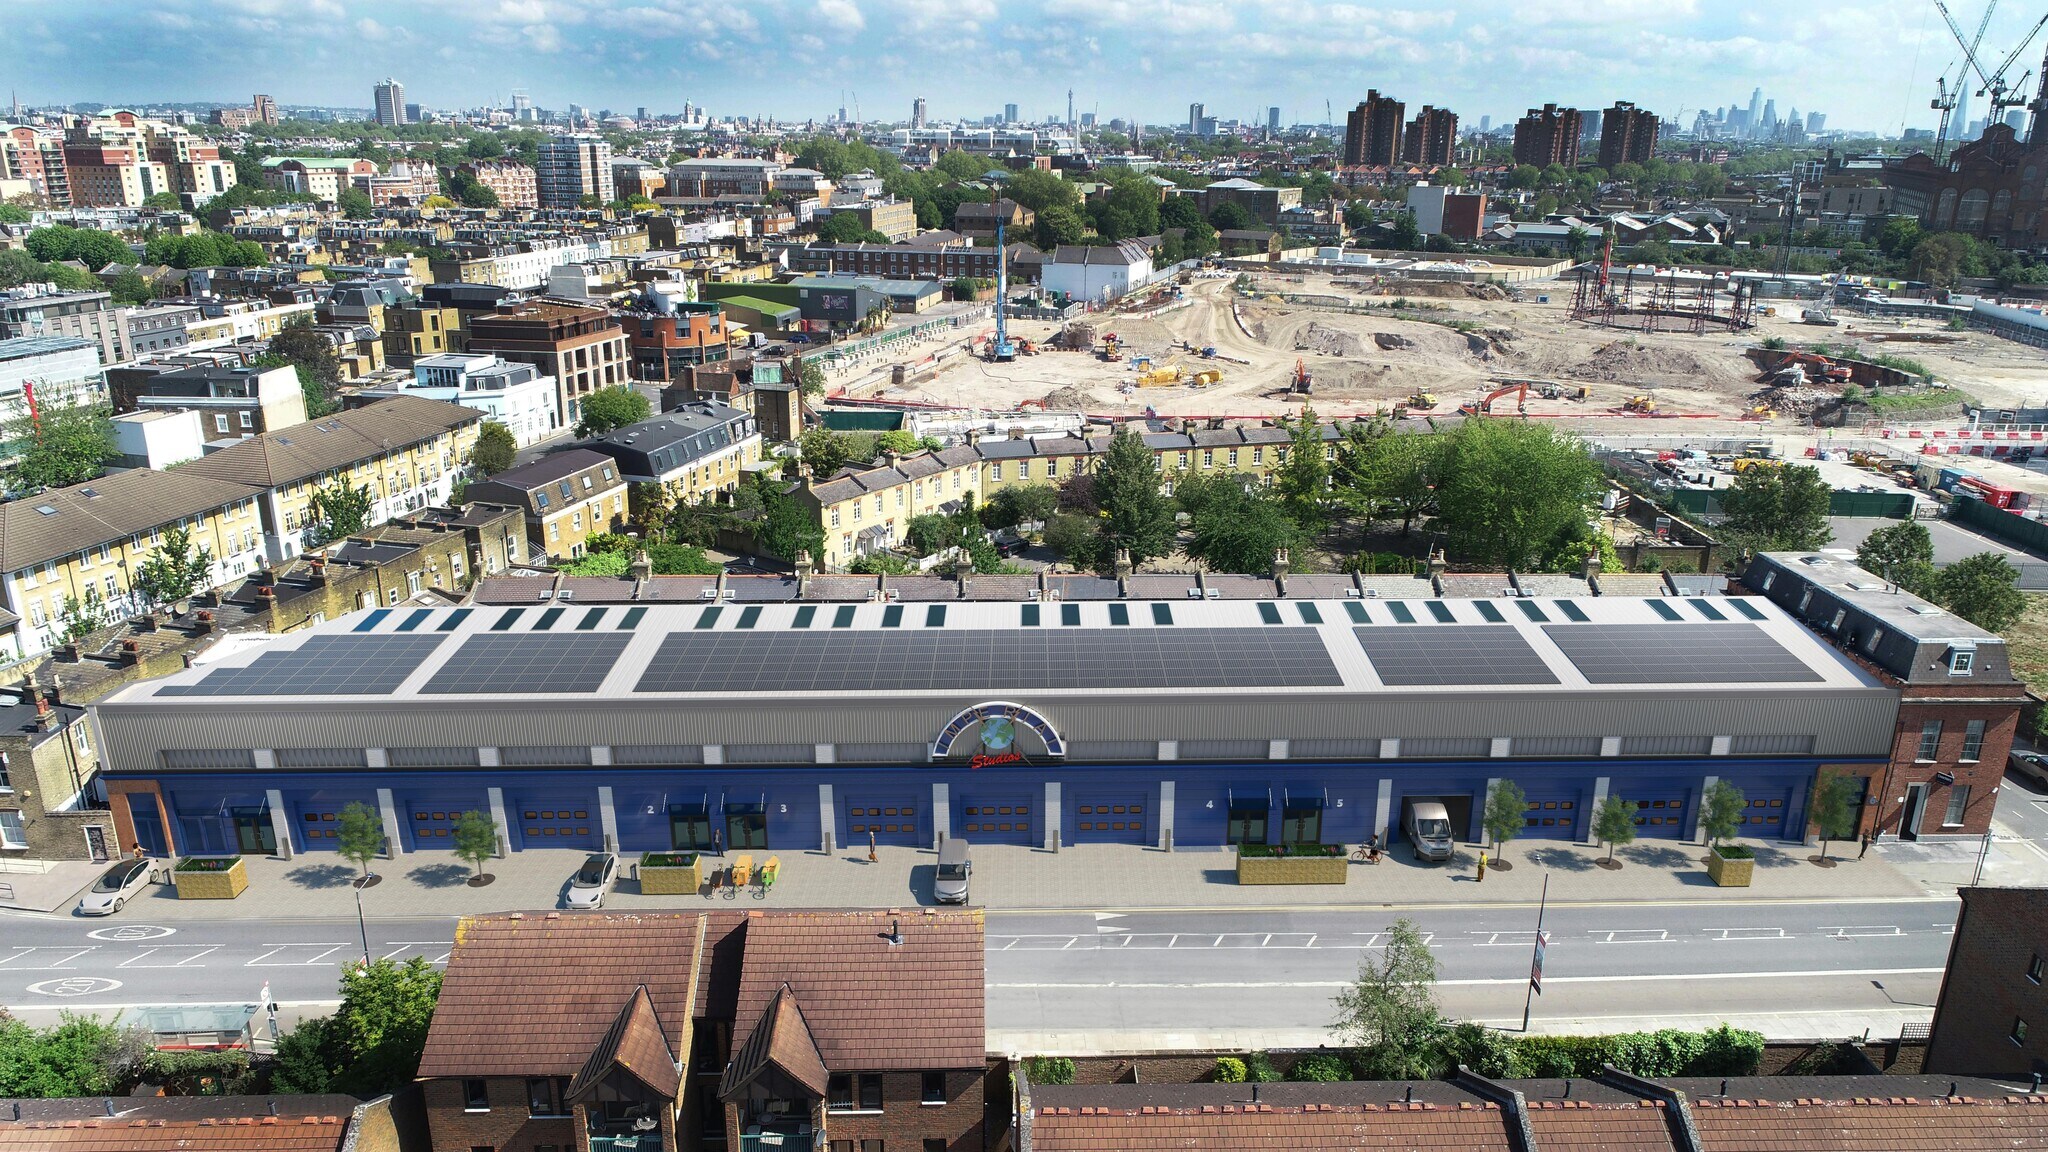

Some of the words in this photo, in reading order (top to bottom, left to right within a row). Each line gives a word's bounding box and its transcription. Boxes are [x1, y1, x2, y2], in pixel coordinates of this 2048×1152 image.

[972, 752, 1021, 769] Studios
[1205, 800, 1214, 809] 4
[1336, 799, 1344, 808] 5
[647, 805, 655, 814] 2
[780, 804, 788, 813] 3
[54, 980, 96, 993] 20
